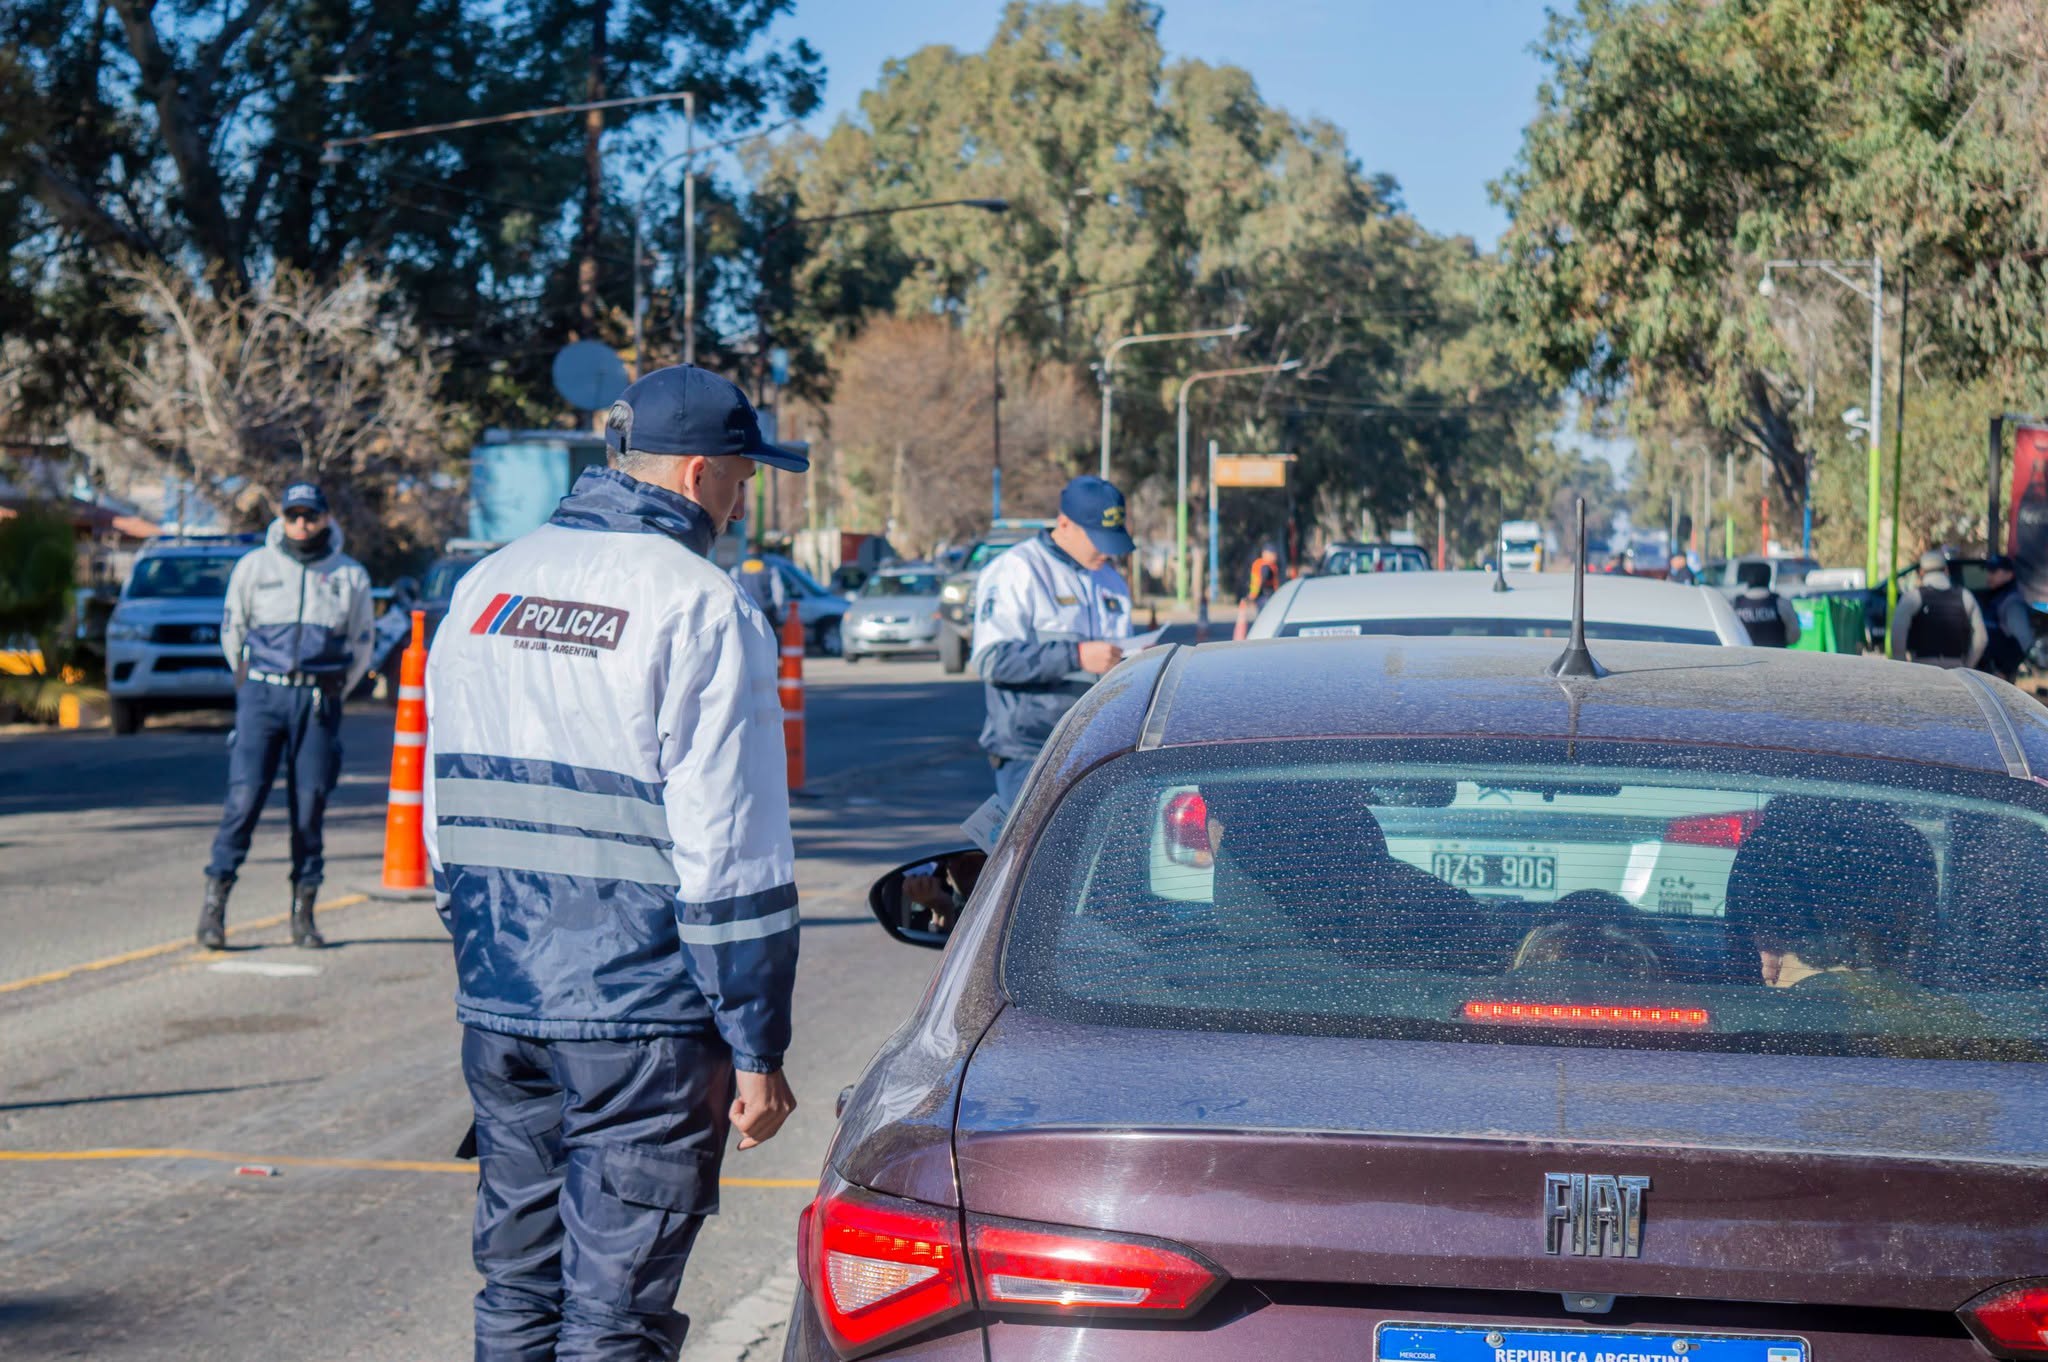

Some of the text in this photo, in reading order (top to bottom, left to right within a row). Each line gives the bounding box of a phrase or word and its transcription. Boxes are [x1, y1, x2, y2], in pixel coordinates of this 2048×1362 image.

[517, 603, 619, 642] POLICIA
[513, 639, 529, 649] SAN
[552, 644, 598, 659] ARGENTINA
[1501, 854, 1553, 888] 906
[1544, 1172, 1651, 1258] FIAT
[1399, 1351, 1437, 1360] MERCOSUR
[1495, 1348, 1588, 1362] REPUBLICA
